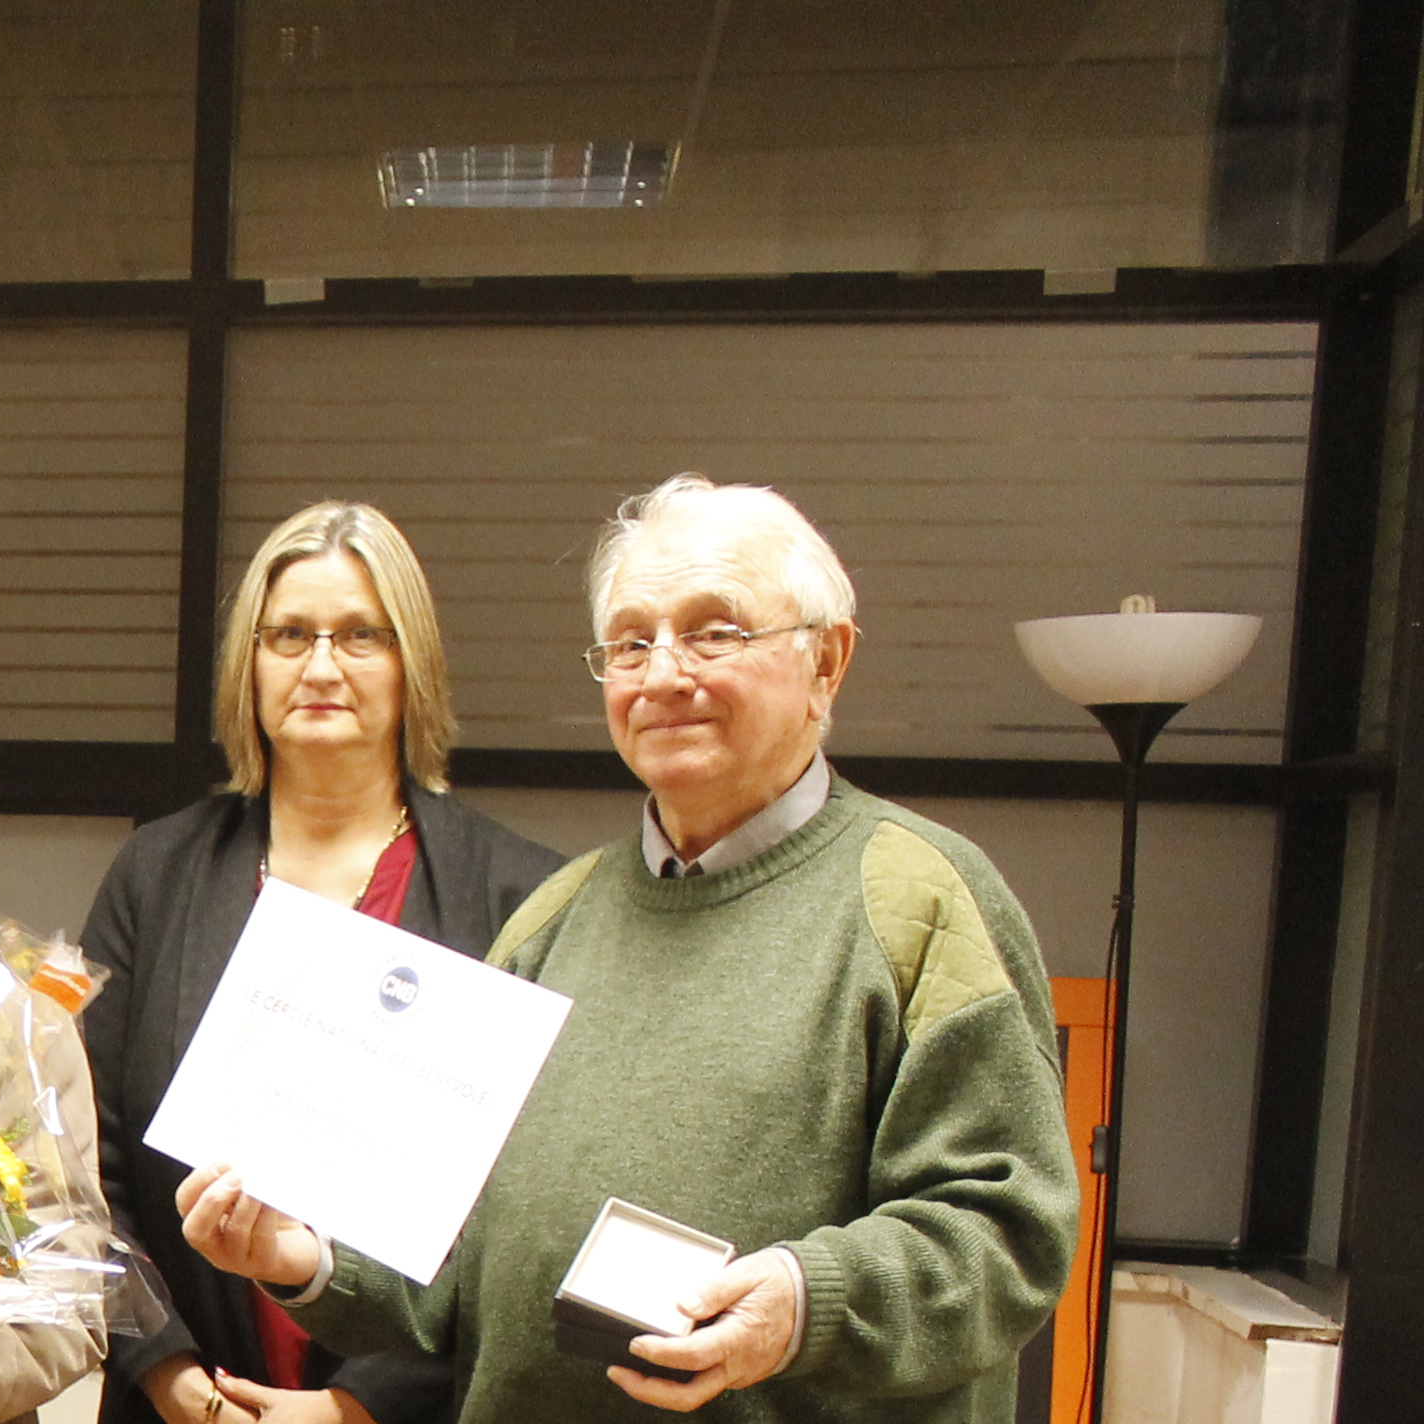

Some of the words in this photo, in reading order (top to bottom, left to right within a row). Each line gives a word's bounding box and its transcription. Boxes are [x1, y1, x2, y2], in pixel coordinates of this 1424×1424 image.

[381, 975, 417, 1003] CNB
[244, 986, 261, 1004] LE
[263, 996, 313, 1027] CERCLE
[315, 1020, 384, 1060] NATIONAL
[389, 1051, 415, 1073] DES
